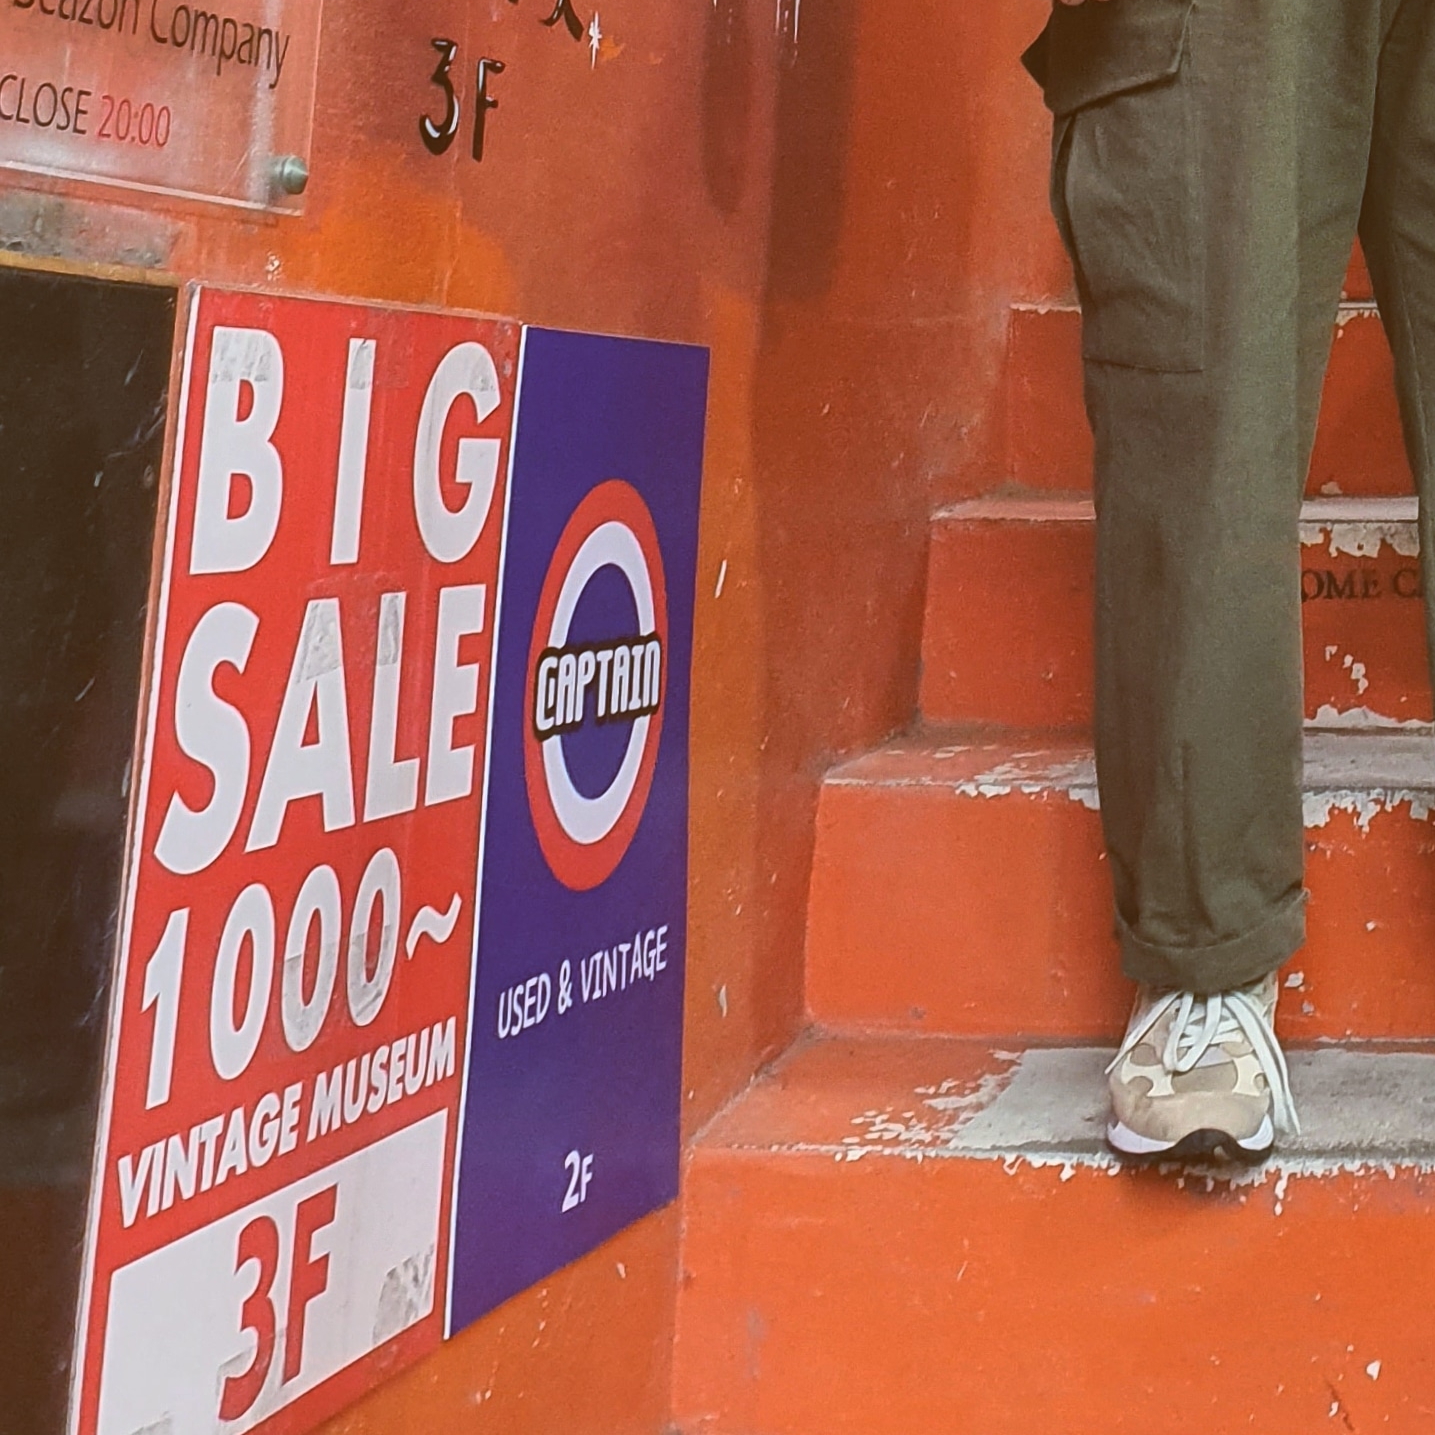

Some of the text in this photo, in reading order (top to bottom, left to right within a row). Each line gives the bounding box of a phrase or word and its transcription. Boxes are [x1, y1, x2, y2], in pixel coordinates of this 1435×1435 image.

[0, 74, 172, 147] CLOSE 20:00
[190, 326, 501, 576] BIG
[154, 584, 486, 875] SALE
[536, 640, 661, 731] CAPTAIN
[498, 924, 669, 1039] USED & VINTAGE
[117, 1017, 458, 1229] VINTAGE MUSEUM
[562, 1150, 594, 1213] 2F
[217, 1181, 339, 1422] 3F
